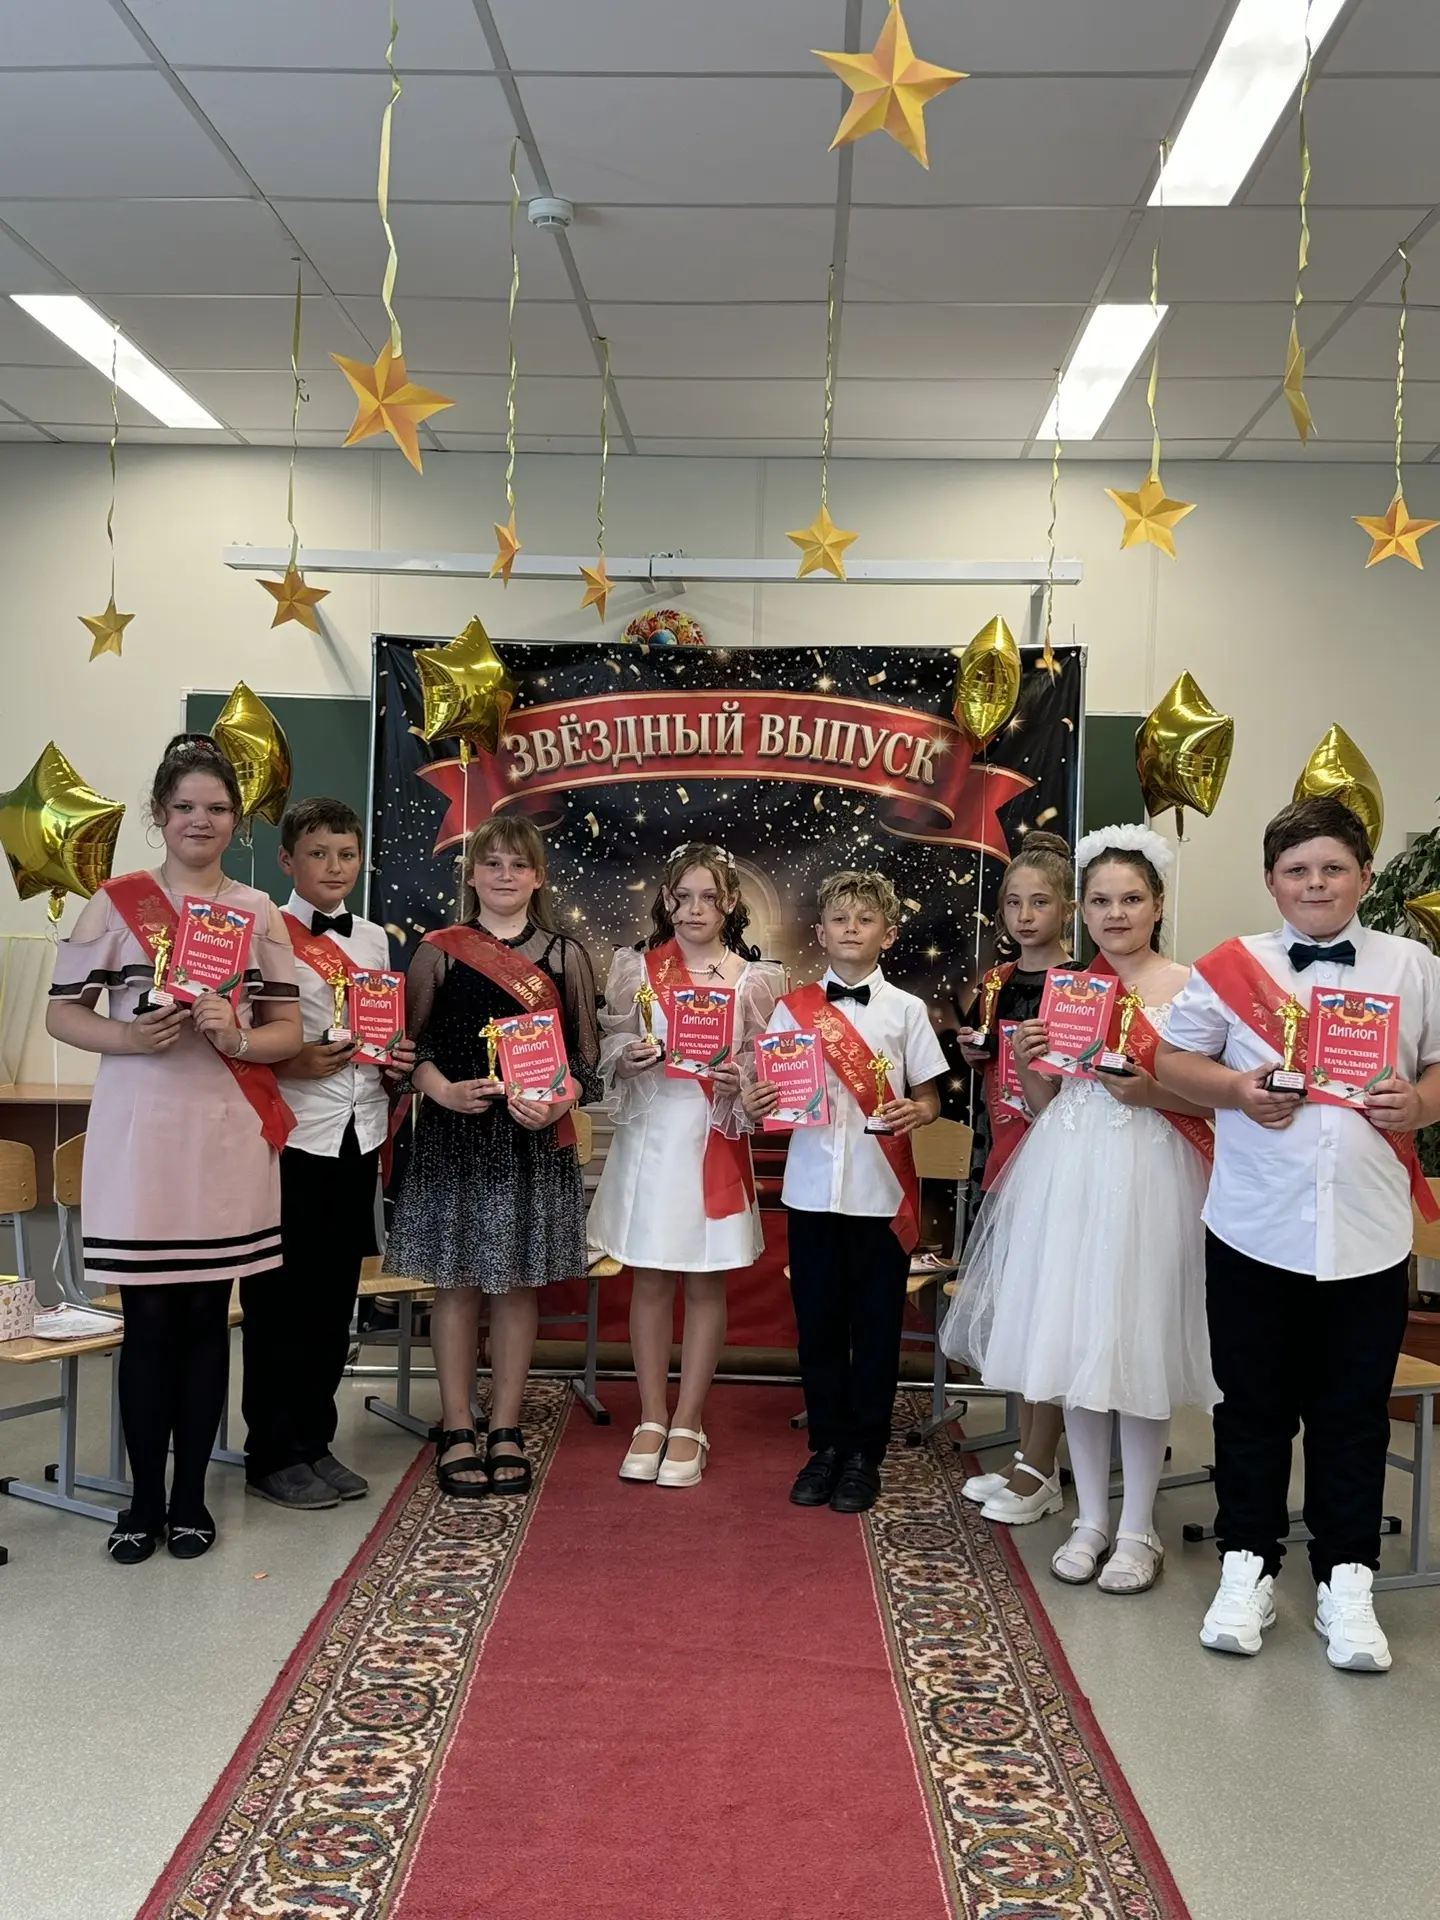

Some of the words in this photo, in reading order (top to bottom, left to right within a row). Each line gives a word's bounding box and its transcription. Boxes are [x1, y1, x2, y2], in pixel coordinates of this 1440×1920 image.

[506, 701, 744, 778] ЗВЁЗДНЫЙ
[757, 713, 935, 785] ВЫПУСК
[187, 949, 233, 966] ВЫПУСКНИК
[186, 959, 230, 976] НАЧАЛЬНОЙ
[192, 968, 221, 980] ШКОЛЫ
[679, 1032, 720, 1041] ВЫПУСКНИК
[679, 1041, 719, 1050] НАЧАЛЬНОЙ
[685, 1048, 711, 1056] ШКОЛЫ
[1324, 1046, 1380, 1059] ВЫПУСКНИК
[1324, 1057, 1378, 1070] НАЧАЛЬНОЙ
[1332, 1067, 1368, 1078] ШКОЛЫ
[775, 1078, 812, 1088] ЫПУСКНИК
[778, 1086, 813, 1097] АЧАЛЬНОЙ
